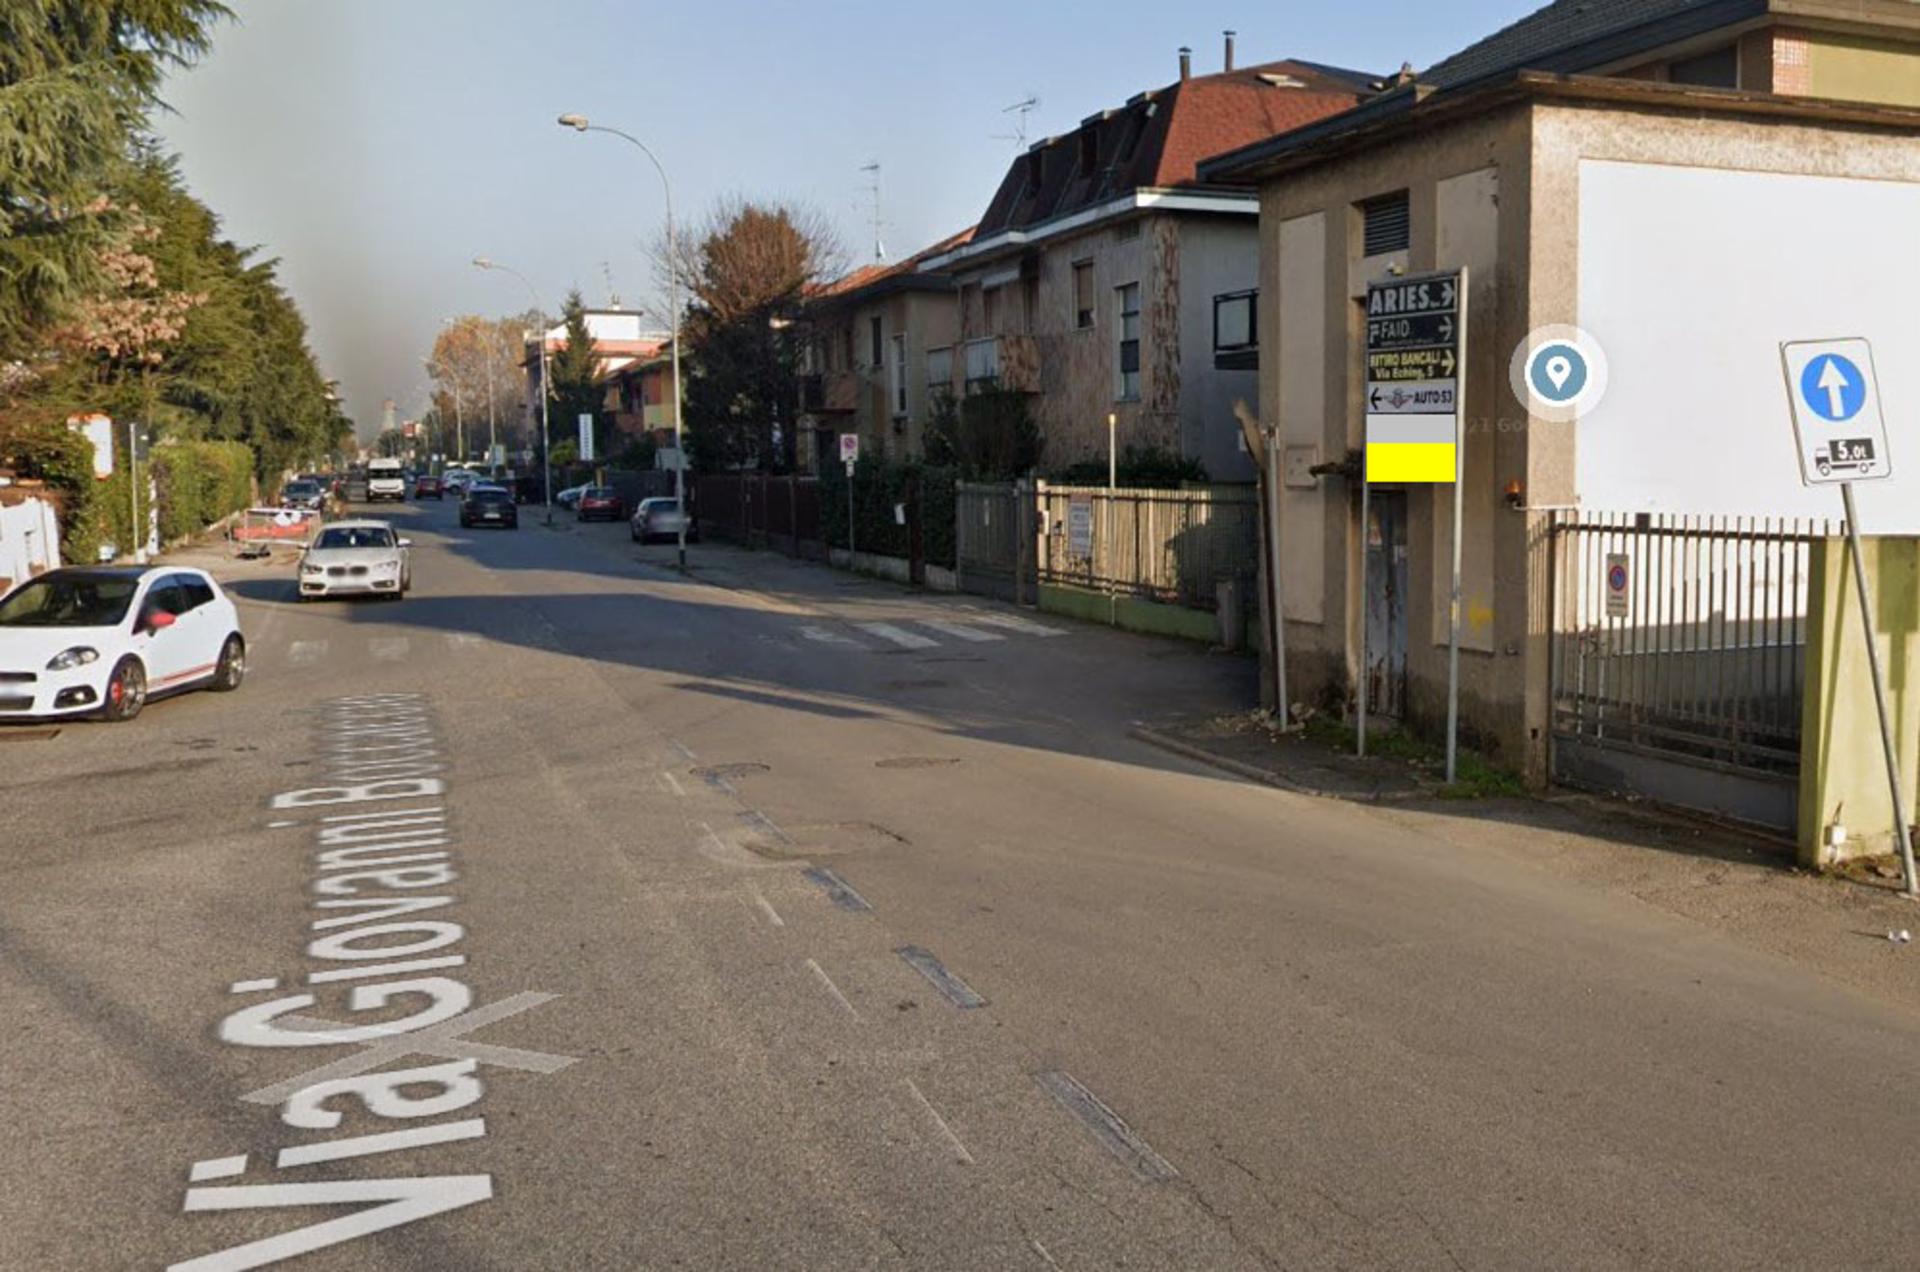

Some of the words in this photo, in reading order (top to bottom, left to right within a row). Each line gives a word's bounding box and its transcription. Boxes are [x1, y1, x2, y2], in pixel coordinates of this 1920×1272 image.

[1370, 284, 1430, 314] ARIES
[1376, 367, 1391, 379] Via
[1414, 390, 1441, 404] AUTO
